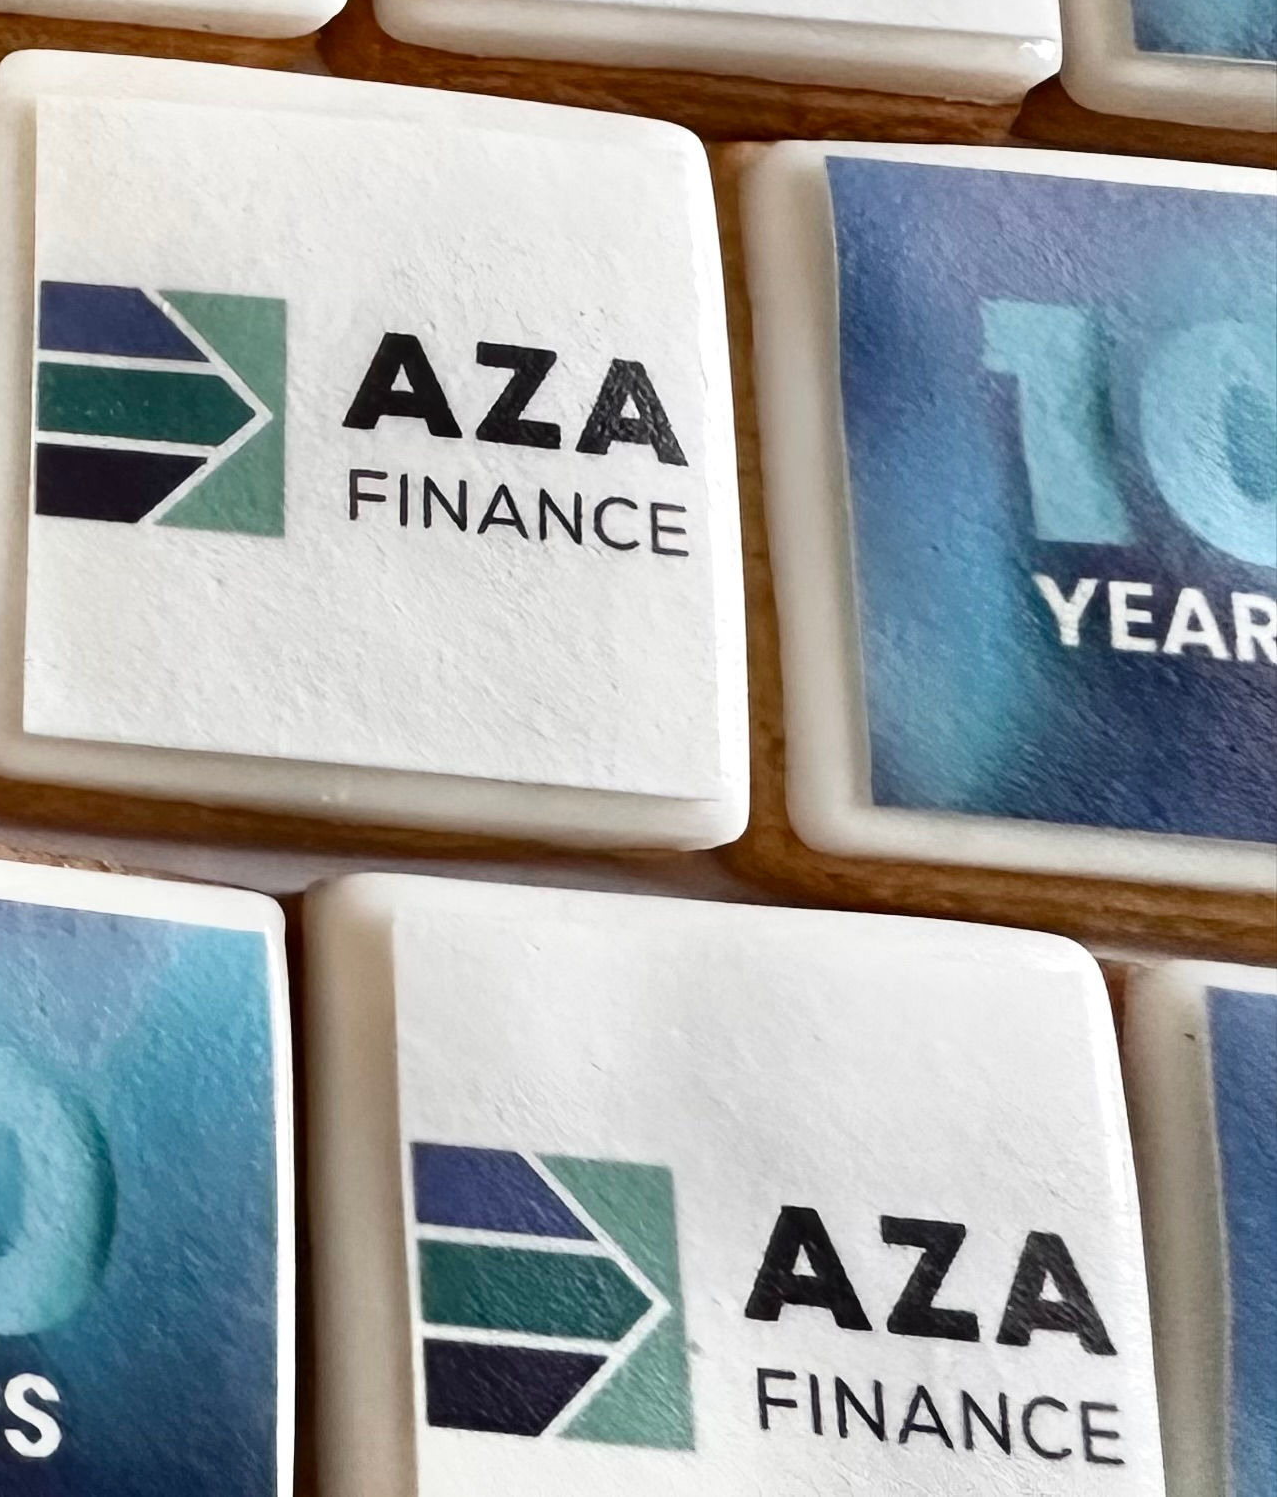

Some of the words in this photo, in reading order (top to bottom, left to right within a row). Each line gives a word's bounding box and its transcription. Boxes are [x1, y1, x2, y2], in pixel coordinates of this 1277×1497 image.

[341, 331, 689, 467] AZA
[349, 468, 689, 557] FINANCE
[1036, 575, 1277, 665] YEAR
[744, 1205, 1118, 1356] AZA
[756, 1367, 1125, 1466] FINANCE
